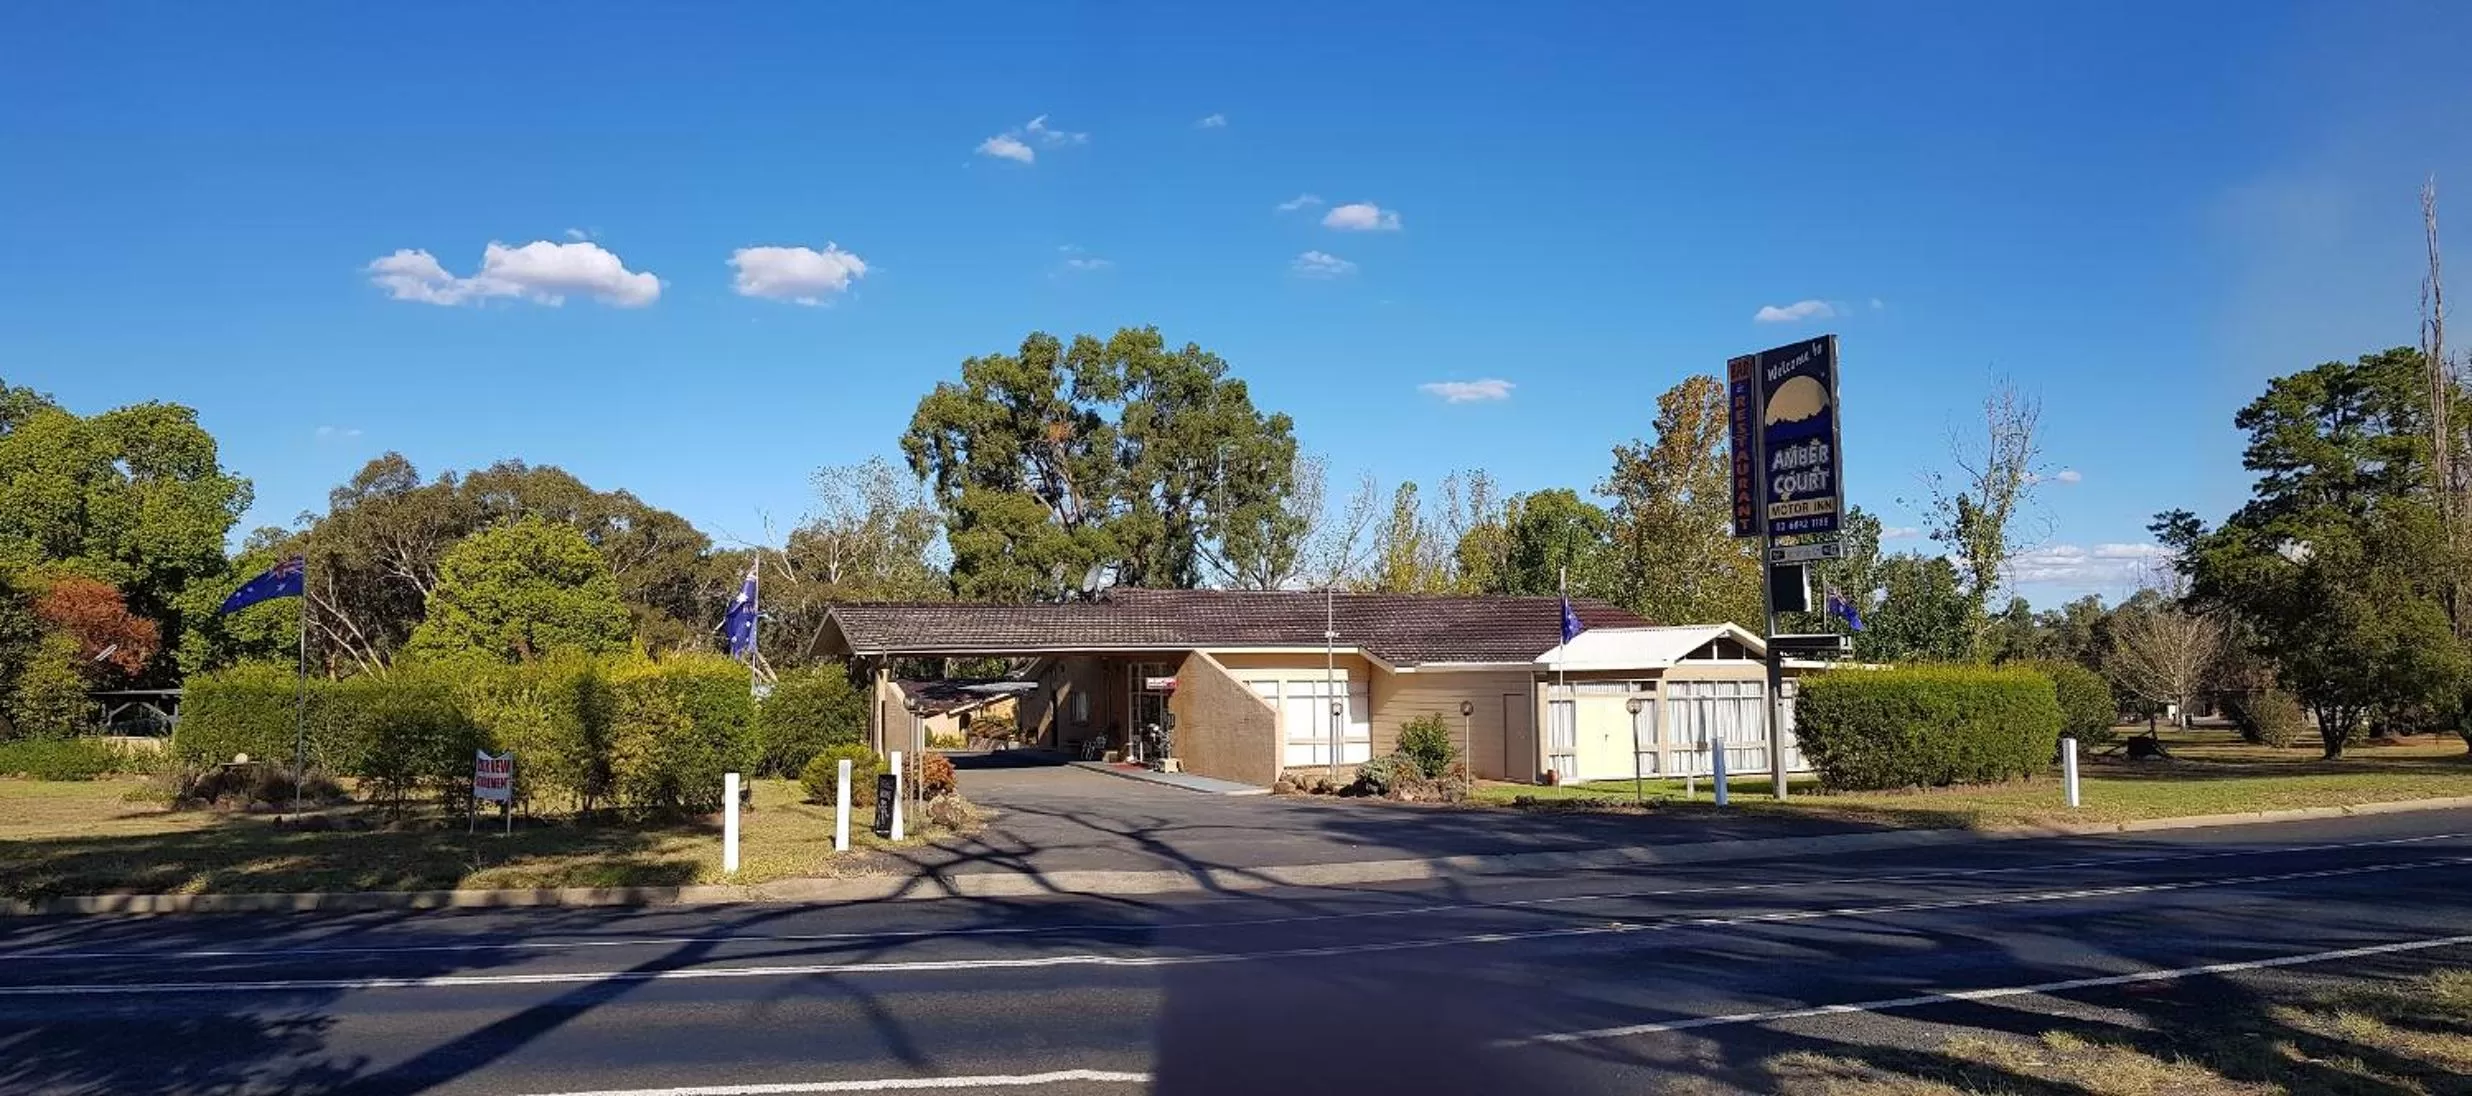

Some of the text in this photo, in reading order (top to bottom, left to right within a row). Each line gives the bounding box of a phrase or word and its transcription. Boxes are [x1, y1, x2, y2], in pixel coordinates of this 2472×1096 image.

[1768, 351, 1810, 381] Welcome
[1735, 396, 1751, 530] RESTAURANT
[1771, 442, 1829, 472] AMBER
[1774, 469, 1830, 494] COURT
[1772, 499, 1832, 516] MOTOR INN
